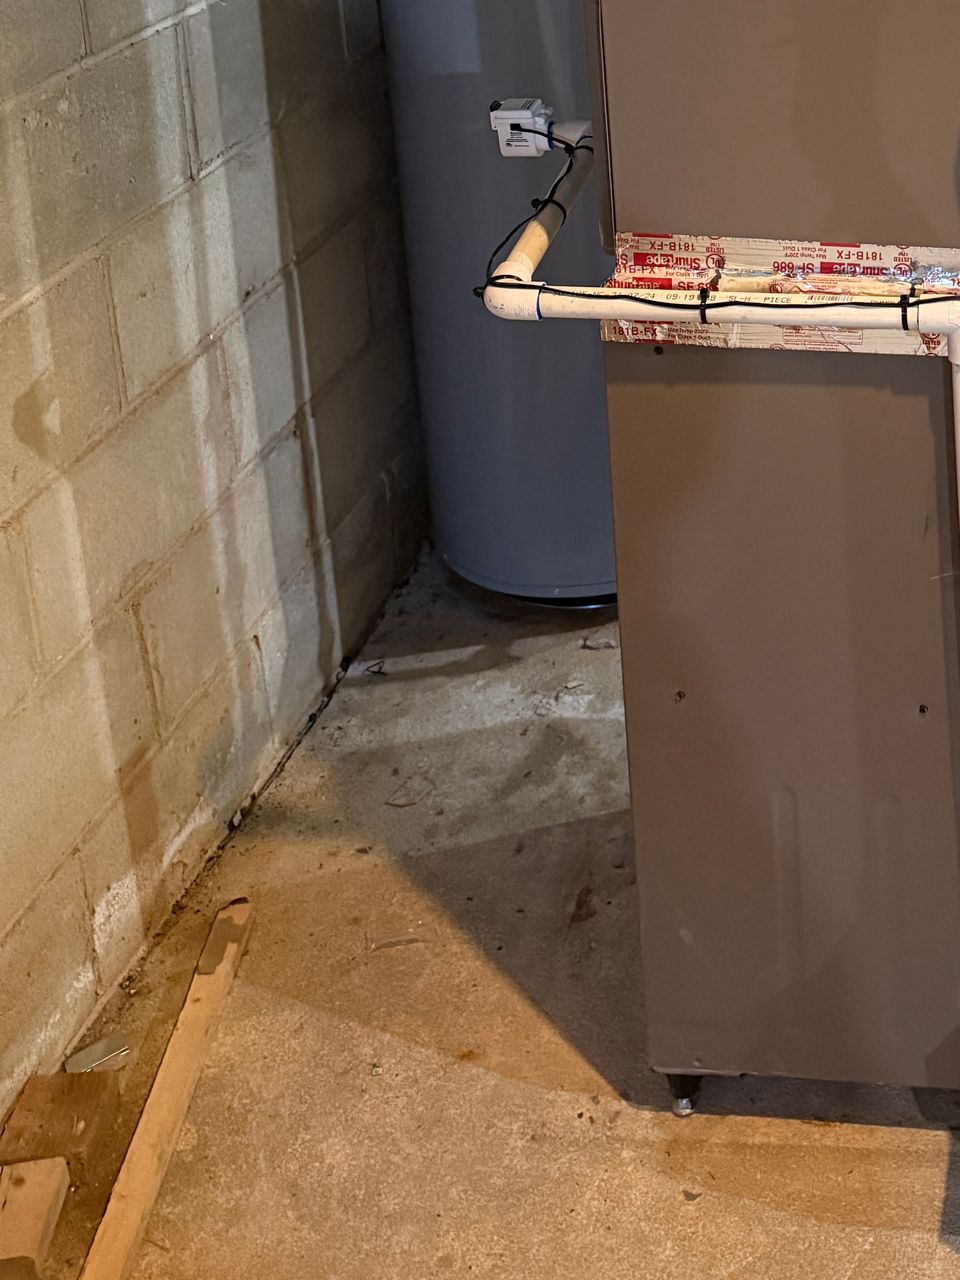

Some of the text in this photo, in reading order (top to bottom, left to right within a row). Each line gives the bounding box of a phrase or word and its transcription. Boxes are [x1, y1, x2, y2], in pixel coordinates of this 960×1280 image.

[649, 240, 695, 251] 181B-FX
[836, 250, 884, 261] 181B-FX
[646, 255, 701, 269] Shurtape
[773, 261, 795, 274] 686
[612, 326, 658, 337] 181B-FX
